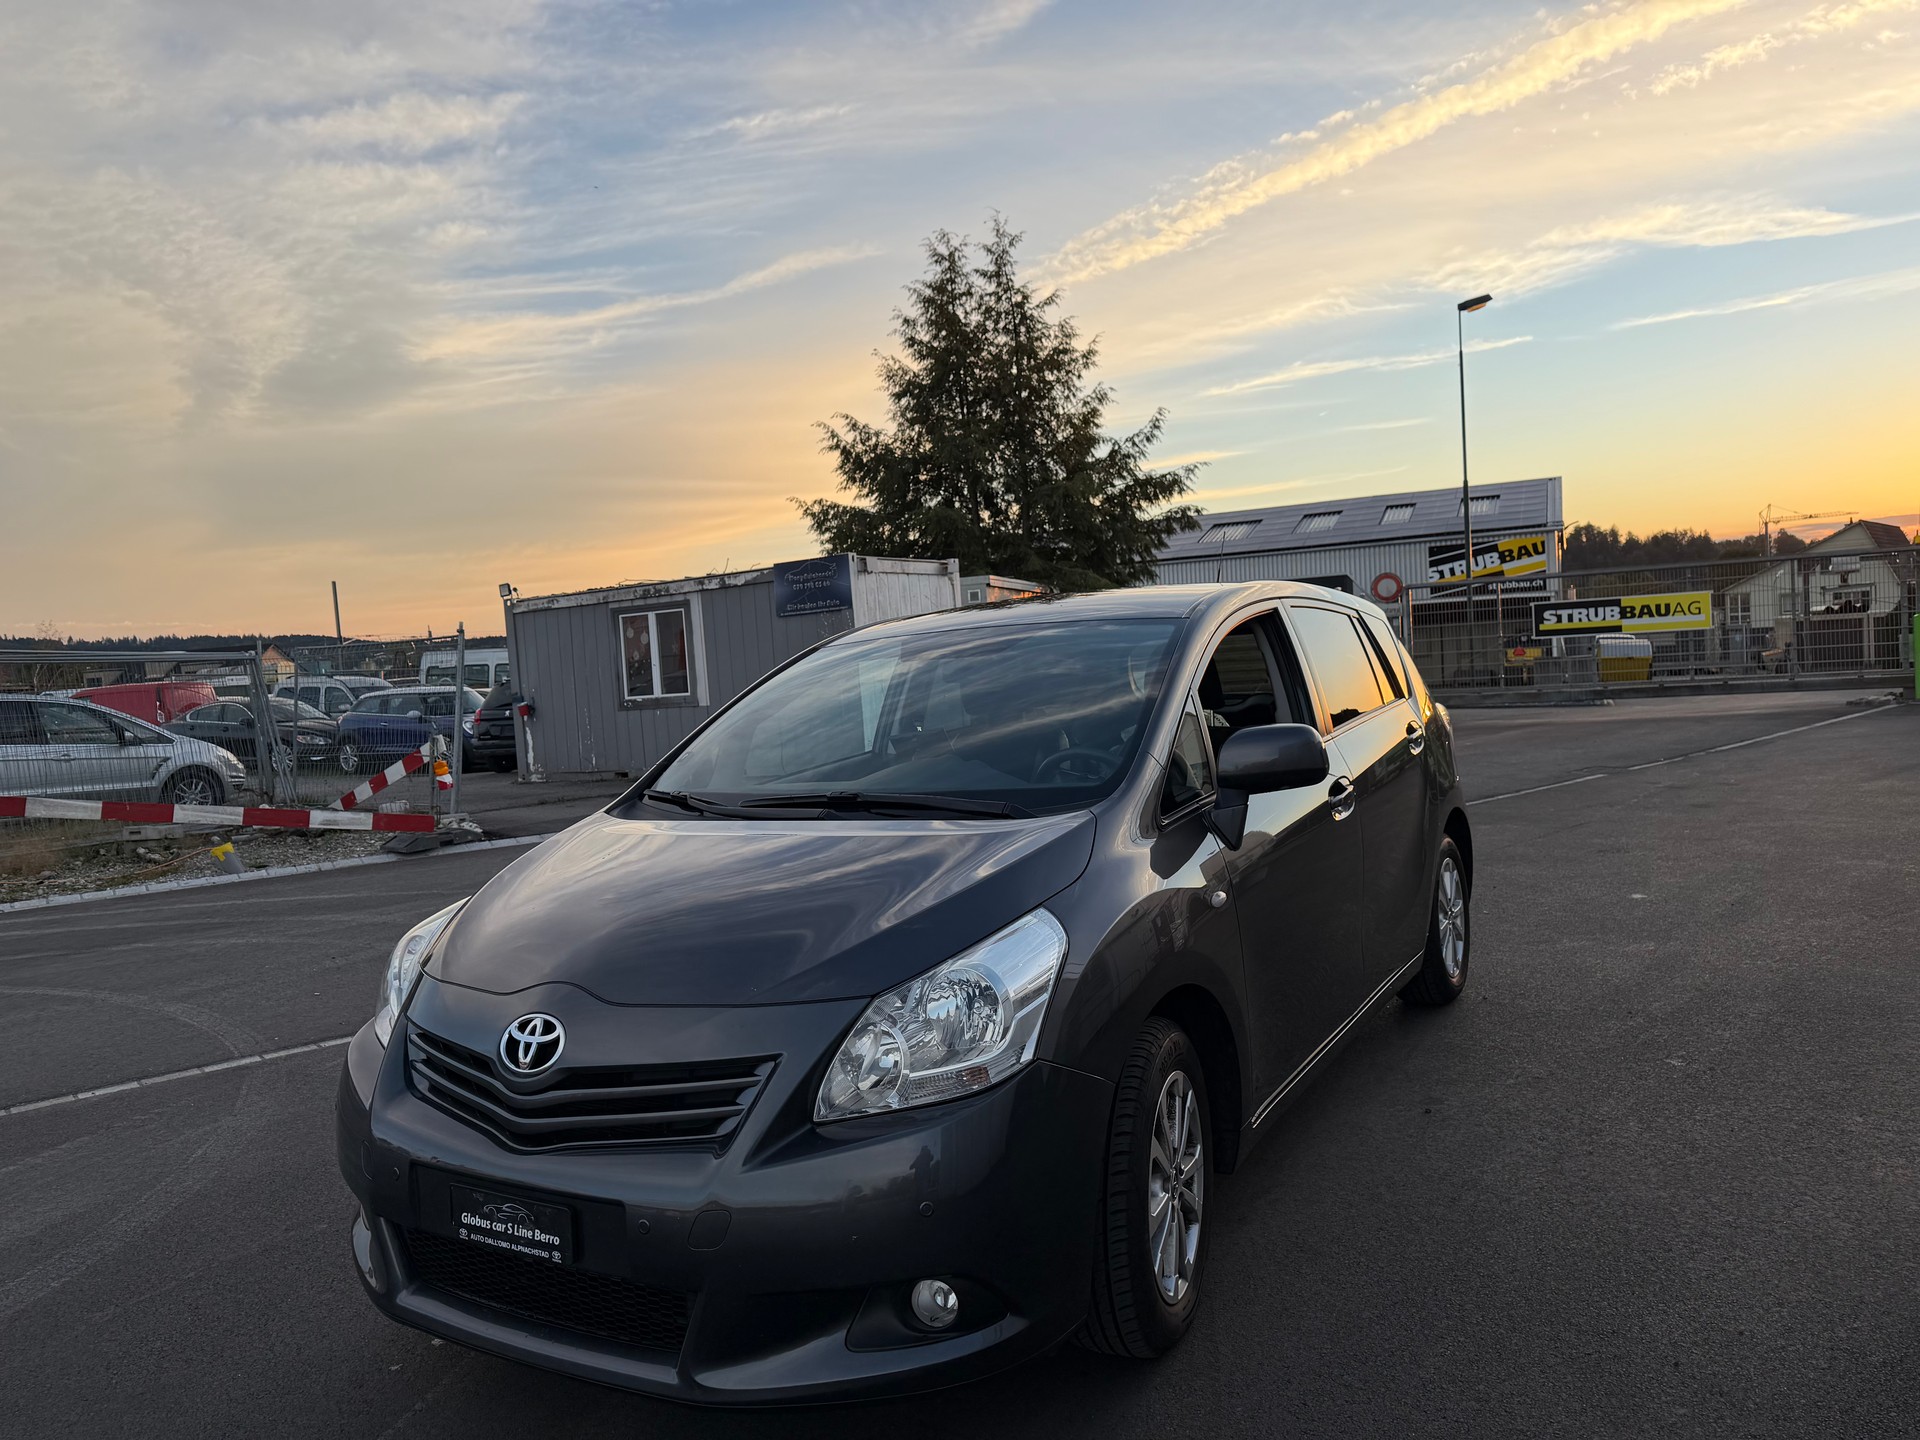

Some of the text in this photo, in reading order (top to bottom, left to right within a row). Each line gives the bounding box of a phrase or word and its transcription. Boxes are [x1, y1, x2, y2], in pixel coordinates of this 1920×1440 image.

[1428, 540, 1546, 582] STRUBBAU
[1487, 579, 1543, 590] stubbau.ch
[461, 1212, 560, 1245] Globus car S Line Berro
[470, 1233, 484, 1243] AUTO
